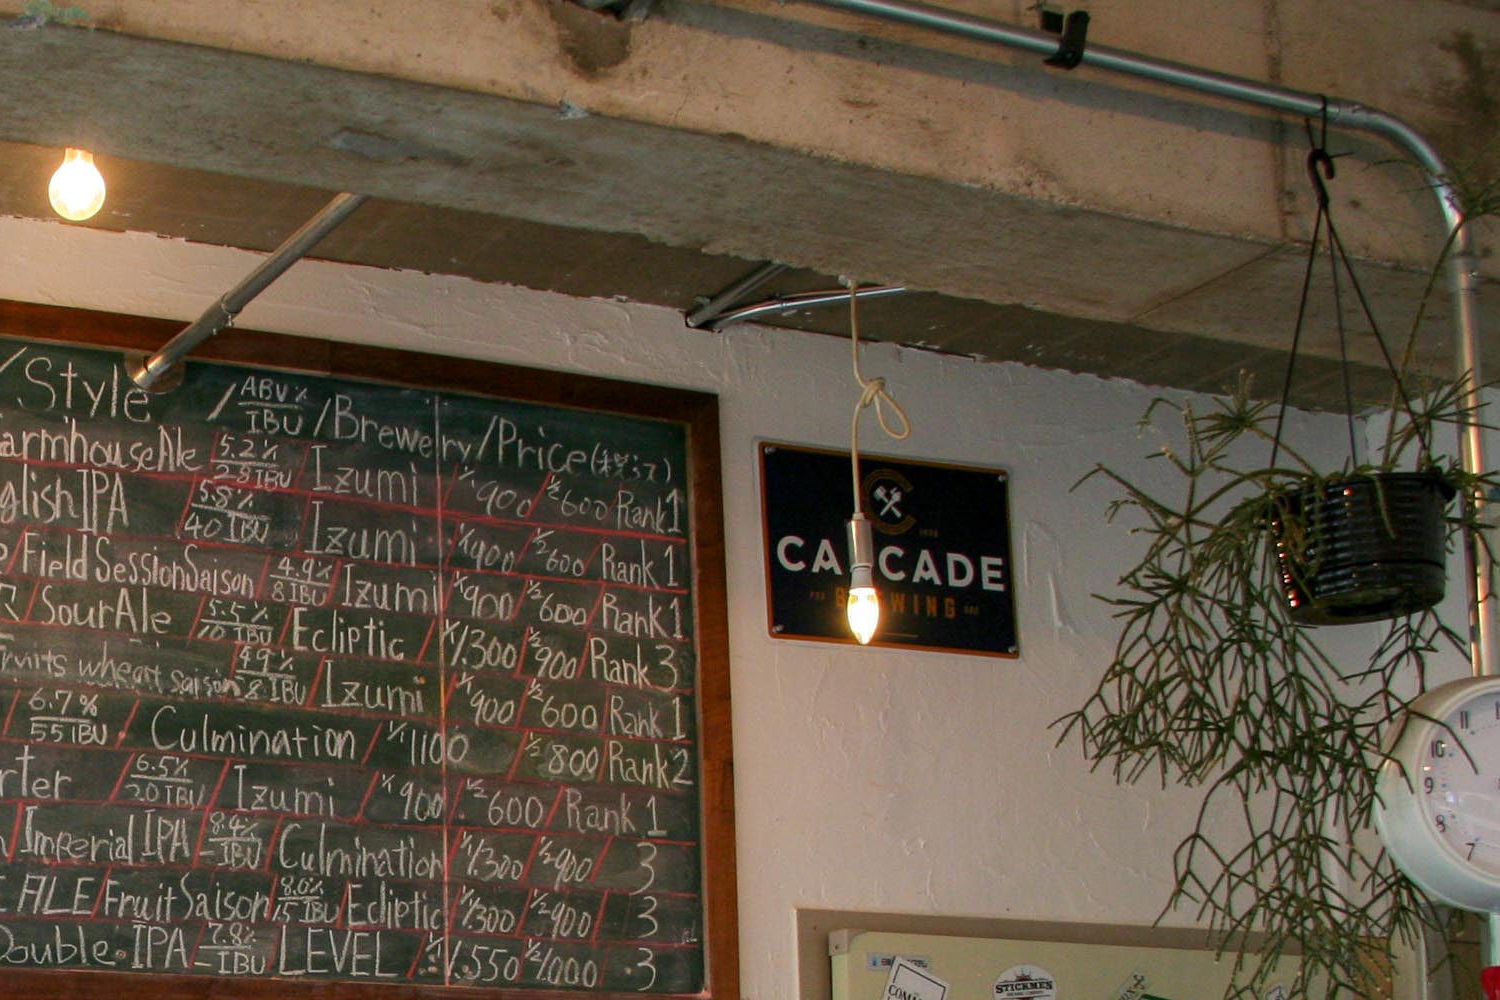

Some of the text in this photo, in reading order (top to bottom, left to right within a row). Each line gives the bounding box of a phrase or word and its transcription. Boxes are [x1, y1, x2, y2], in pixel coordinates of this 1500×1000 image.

[334, 395, 472, 465] Brewery
[311, 445, 419, 507] Izumi
[77, 468, 130, 533] IPA
[310, 501, 417, 567] Izumi
[602, 541, 659, 589] Rank
[776, 535, 1004, 592] CACADE
[23, 531, 87, 581] Field
[342, 563, 438, 615] Izumi
[603, 592, 660, 638] Rank
[294, 608, 404, 660] Ecliptic
[590, 639, 649, 687] Rank
[323, 661, 424, 716] Izumi
[609, 696, 663, 738] Rank
[151, 705, 356, 760] Culmination
[609, 741, 667, 788] Rank
[234, 764, 336, 817] Izumi
[488, 795, 544, 827] 600
[565, 787, 635, 835] Rank
[21, 807, 135, 863] Imperial
[143, 809, 190, 862] IPA
[280, 823, 444, 881] Culmination
[18, 876, 94, 916] ALE
[105, 880, 177, 924] Fruit
[181, 872, 269, 920] Saison
[347, 882, 442, 931] Ecliptic
[132, 920, 189, 969] IPA
[281, 927, 399, 978] LEVEL
